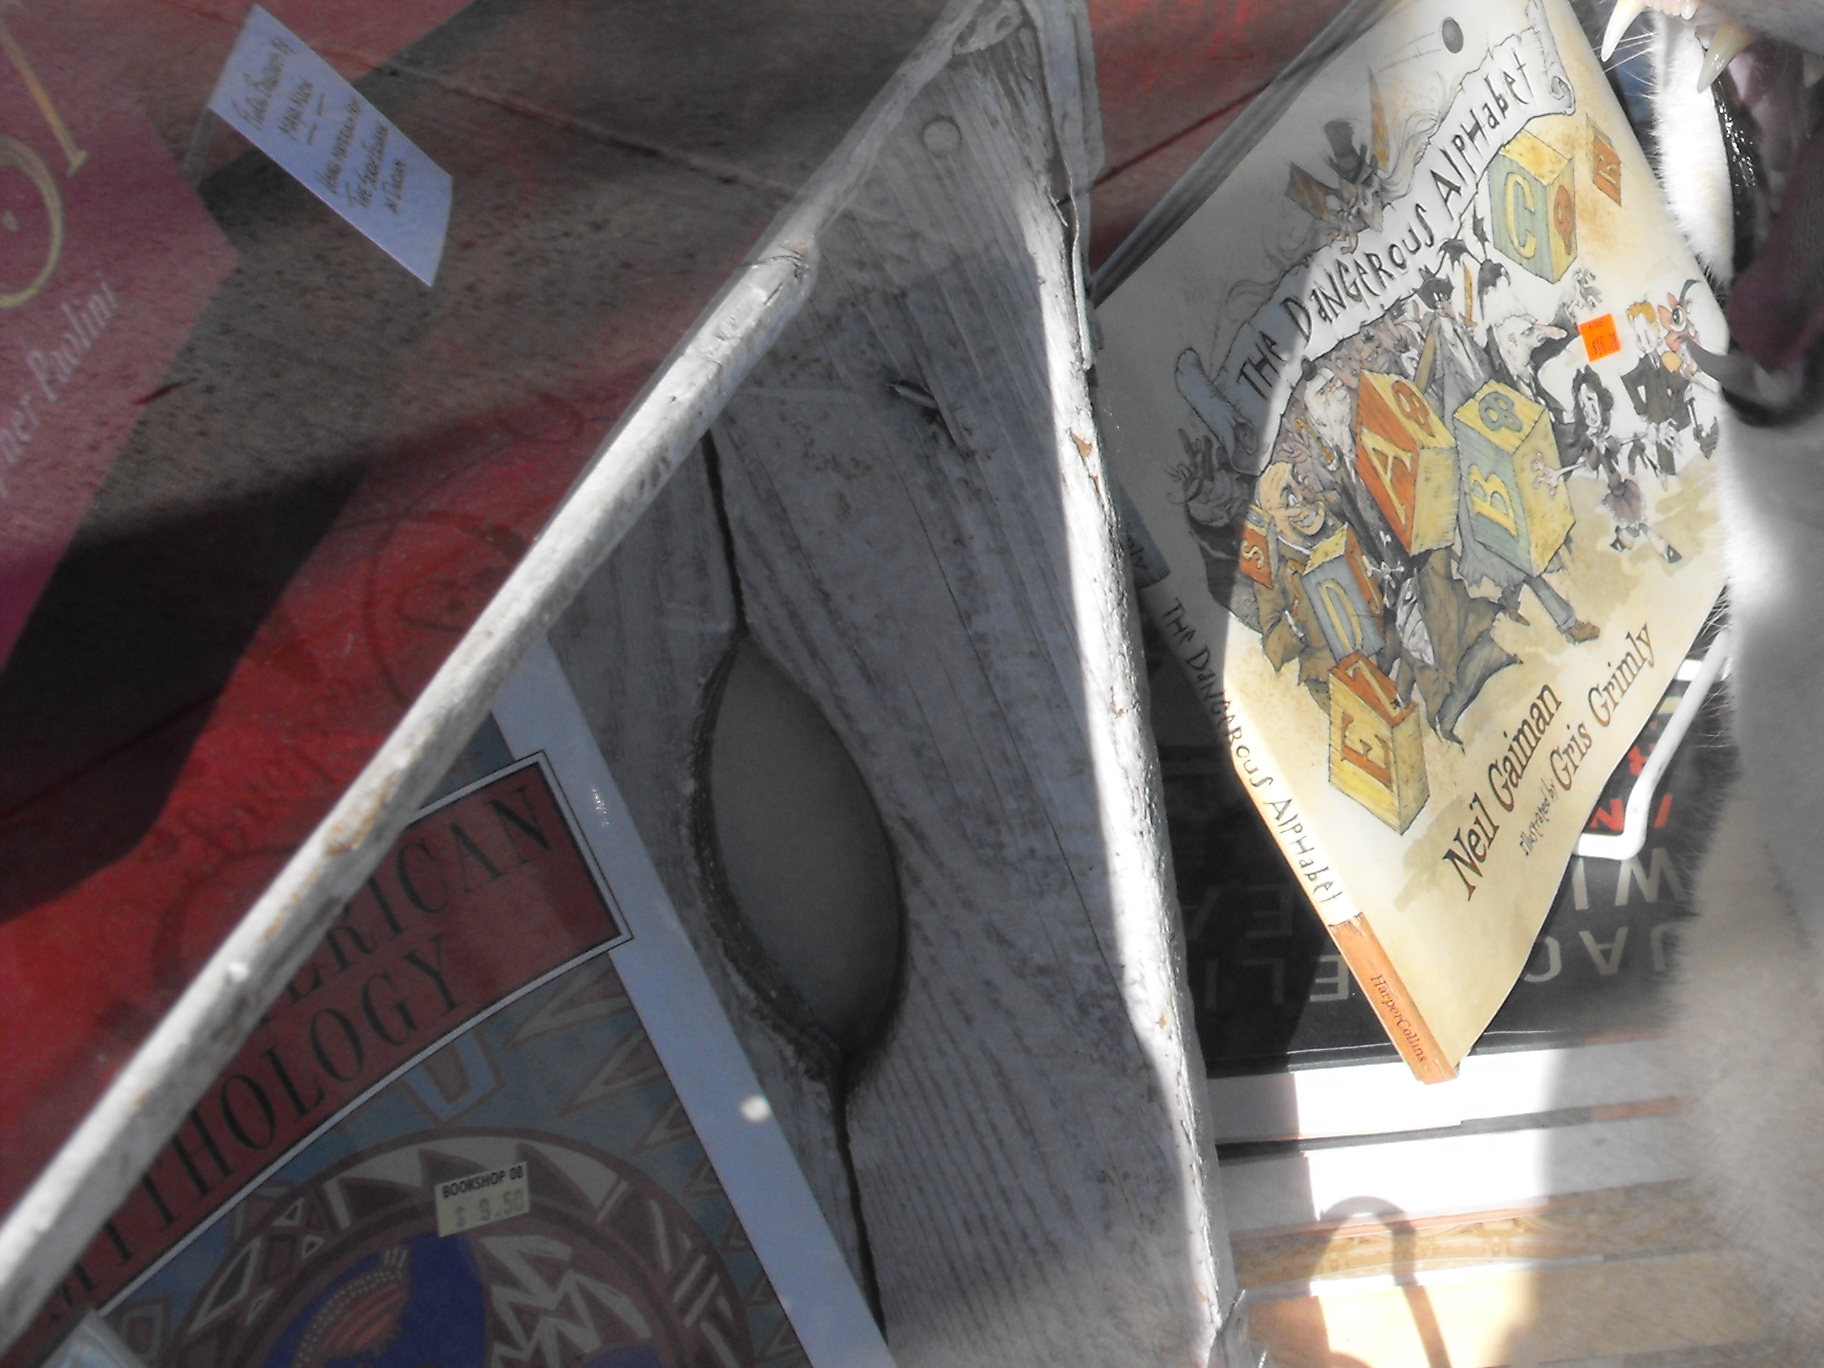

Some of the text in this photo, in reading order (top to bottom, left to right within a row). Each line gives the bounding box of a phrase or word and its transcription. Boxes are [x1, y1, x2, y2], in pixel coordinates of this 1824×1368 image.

[1549, 721, 1592, 792] Gris
[1588, 622, 1655, 727] Grimly
[1442, 684, 1562, 902] Neil Gaiman
[1370, 972, 1429, 1064] HarperCollins
[442, 1170, 506, 1199] BOOKSHOP
